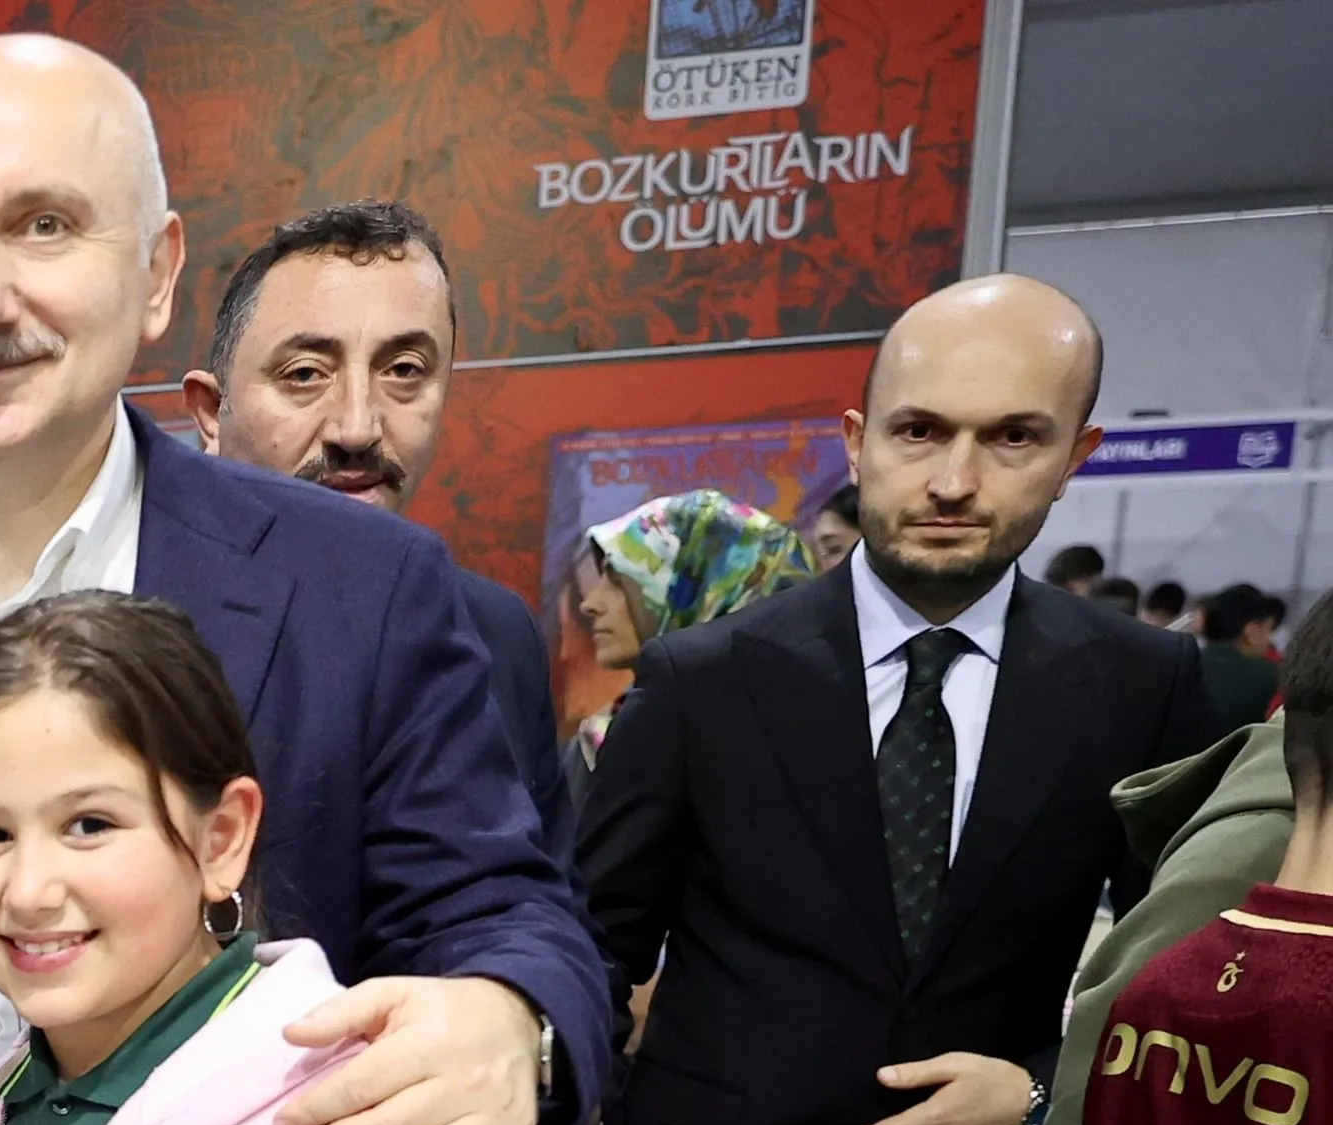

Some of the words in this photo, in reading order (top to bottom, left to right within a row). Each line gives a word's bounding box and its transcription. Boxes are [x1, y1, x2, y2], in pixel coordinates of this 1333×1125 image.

[653, 54, 800, 93] ÖTÜKEN
[535, 126, 913, 209] BOZKURTLARIN
[619, 187, 807, 252] ÖLÜMÜ
[1089, 438, 1187, 463] AYINLARI
